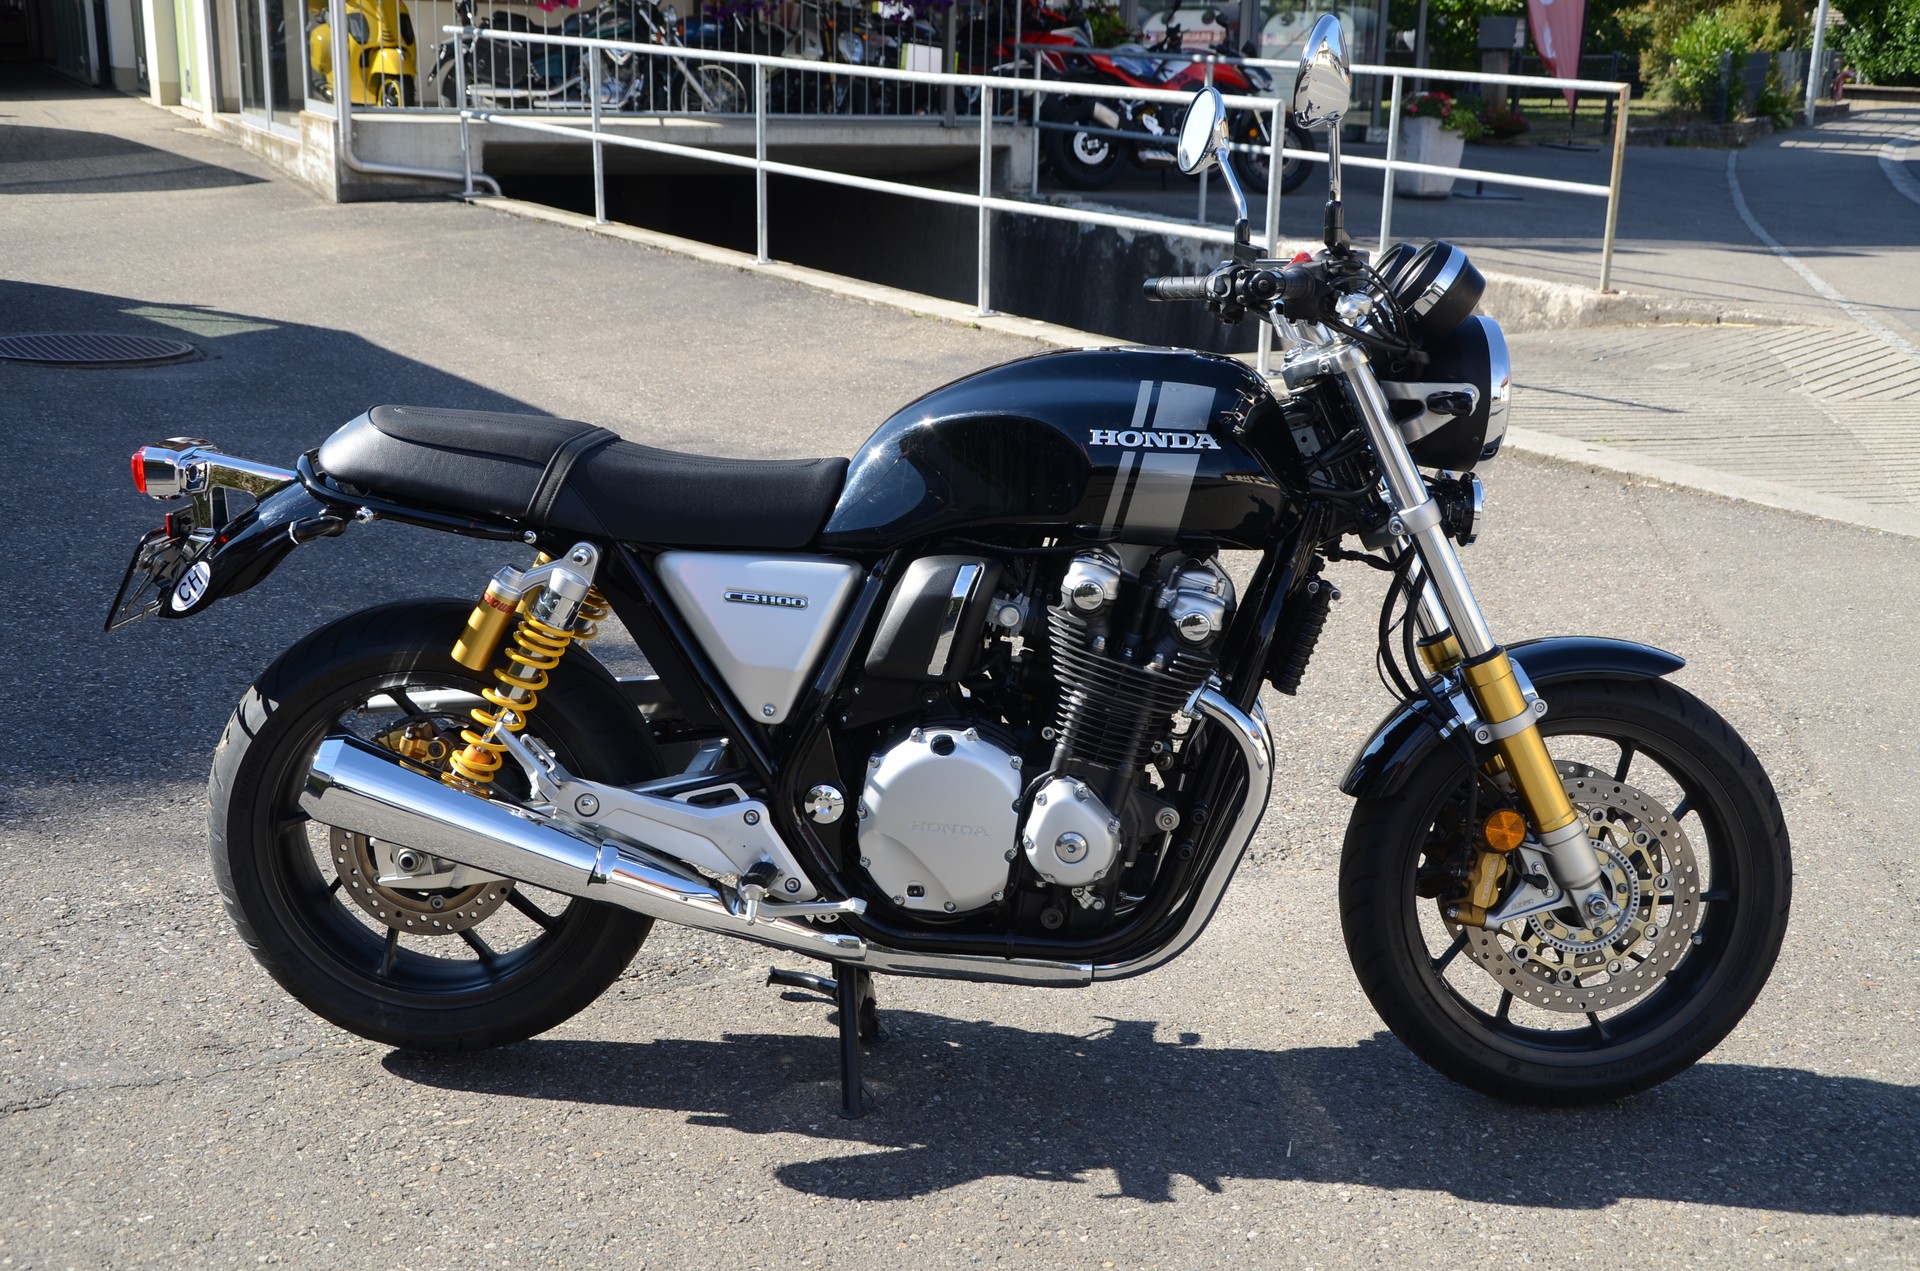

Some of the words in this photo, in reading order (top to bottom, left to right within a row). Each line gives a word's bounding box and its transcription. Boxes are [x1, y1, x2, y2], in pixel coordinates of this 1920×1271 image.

[1089, 429, 1221, 449] HONDA
[178, 569, 204, 602] CH
[725, 592, 806, 608] CB1100
[911, 821, 989, 836] HONDA
